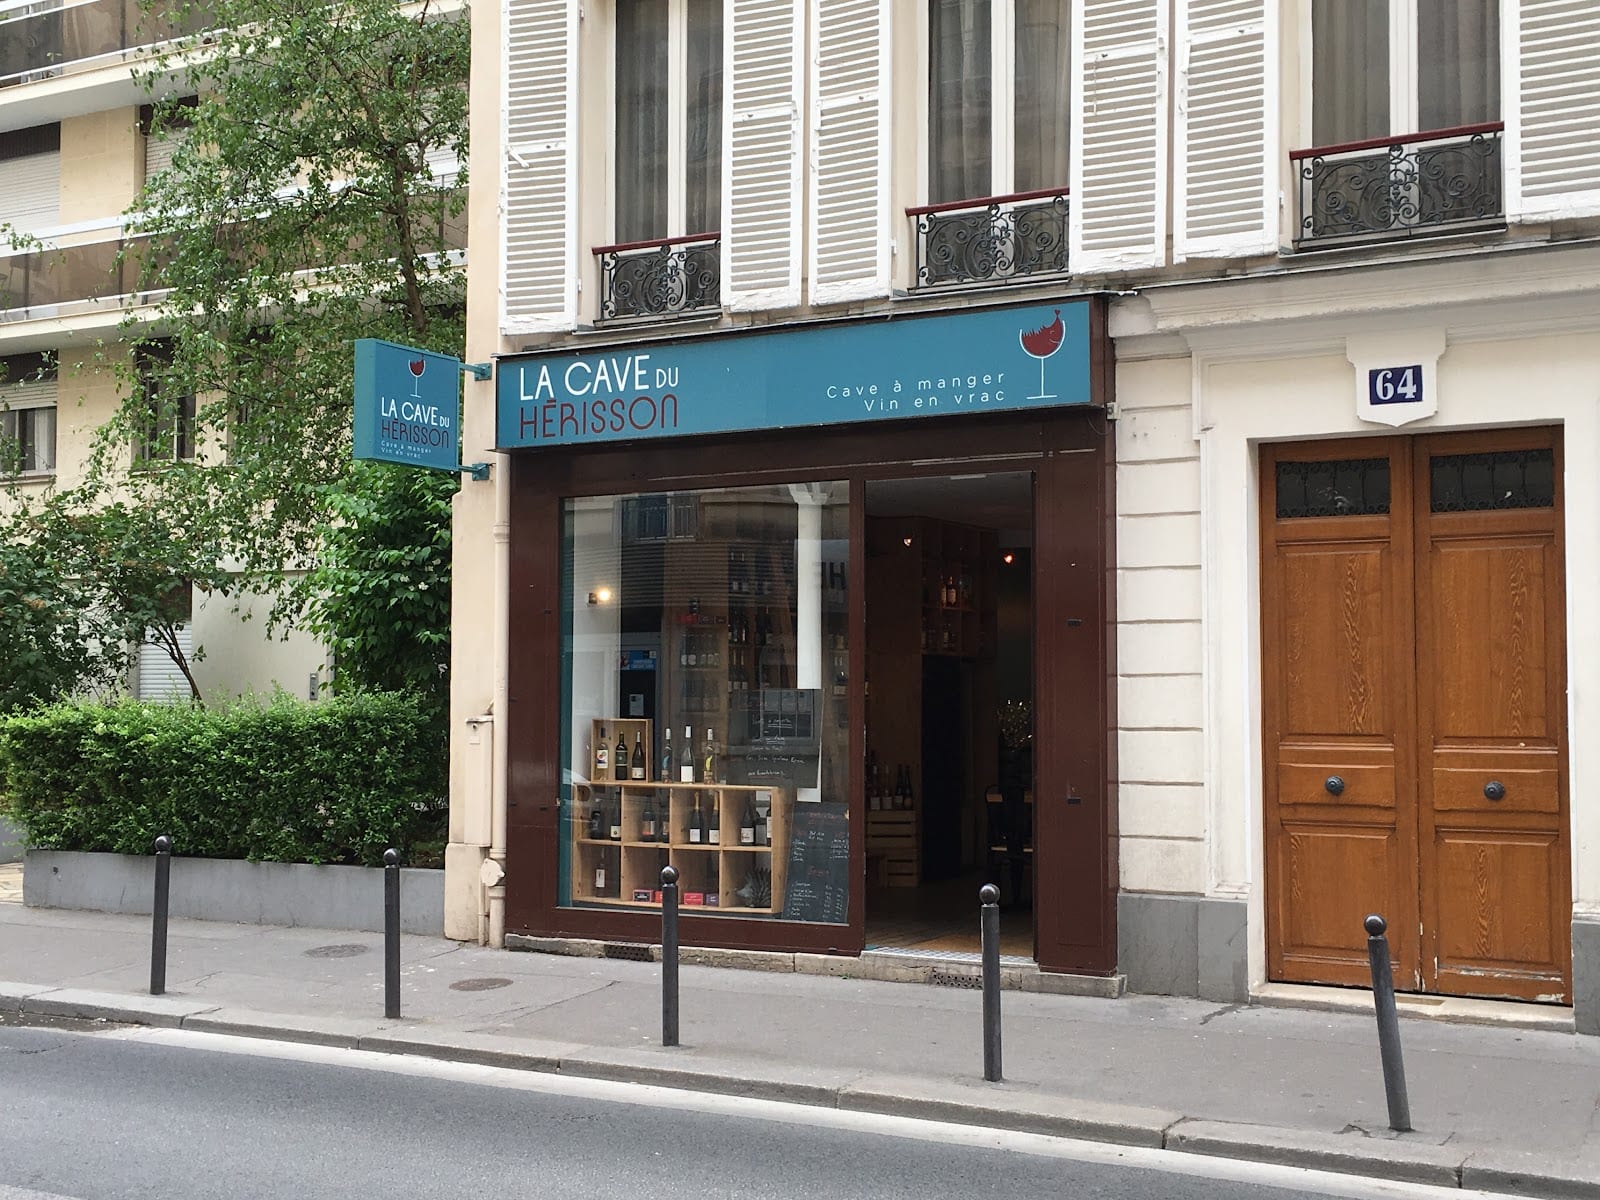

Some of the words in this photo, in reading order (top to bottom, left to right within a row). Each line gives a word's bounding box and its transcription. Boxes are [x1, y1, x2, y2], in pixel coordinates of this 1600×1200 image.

[520, 364, 554, 401] LA
[564, 354, 650, 396] CAVE
[656, 366, 679, 389] DU
[826, 384, 879, 399] Cave
[893, 379, 902, 393] à
[918, 372, 1004, 390] manger
[1375, 368, 1417, 401] 64
[381, 396, 398, 419] LA
[401, 401, 438, 426] CAVE
[439, 415, 450, 428] DU
[520, 393, 678, 440] HÉRISSON
[864, 398, 898, 412] Vin
[914, 395, 938, 408] en
[954, 390, 1004, 405] vrac
[381, 418, 449, 449] HÉRISSON
[381, 447, 393, 455] Vin
